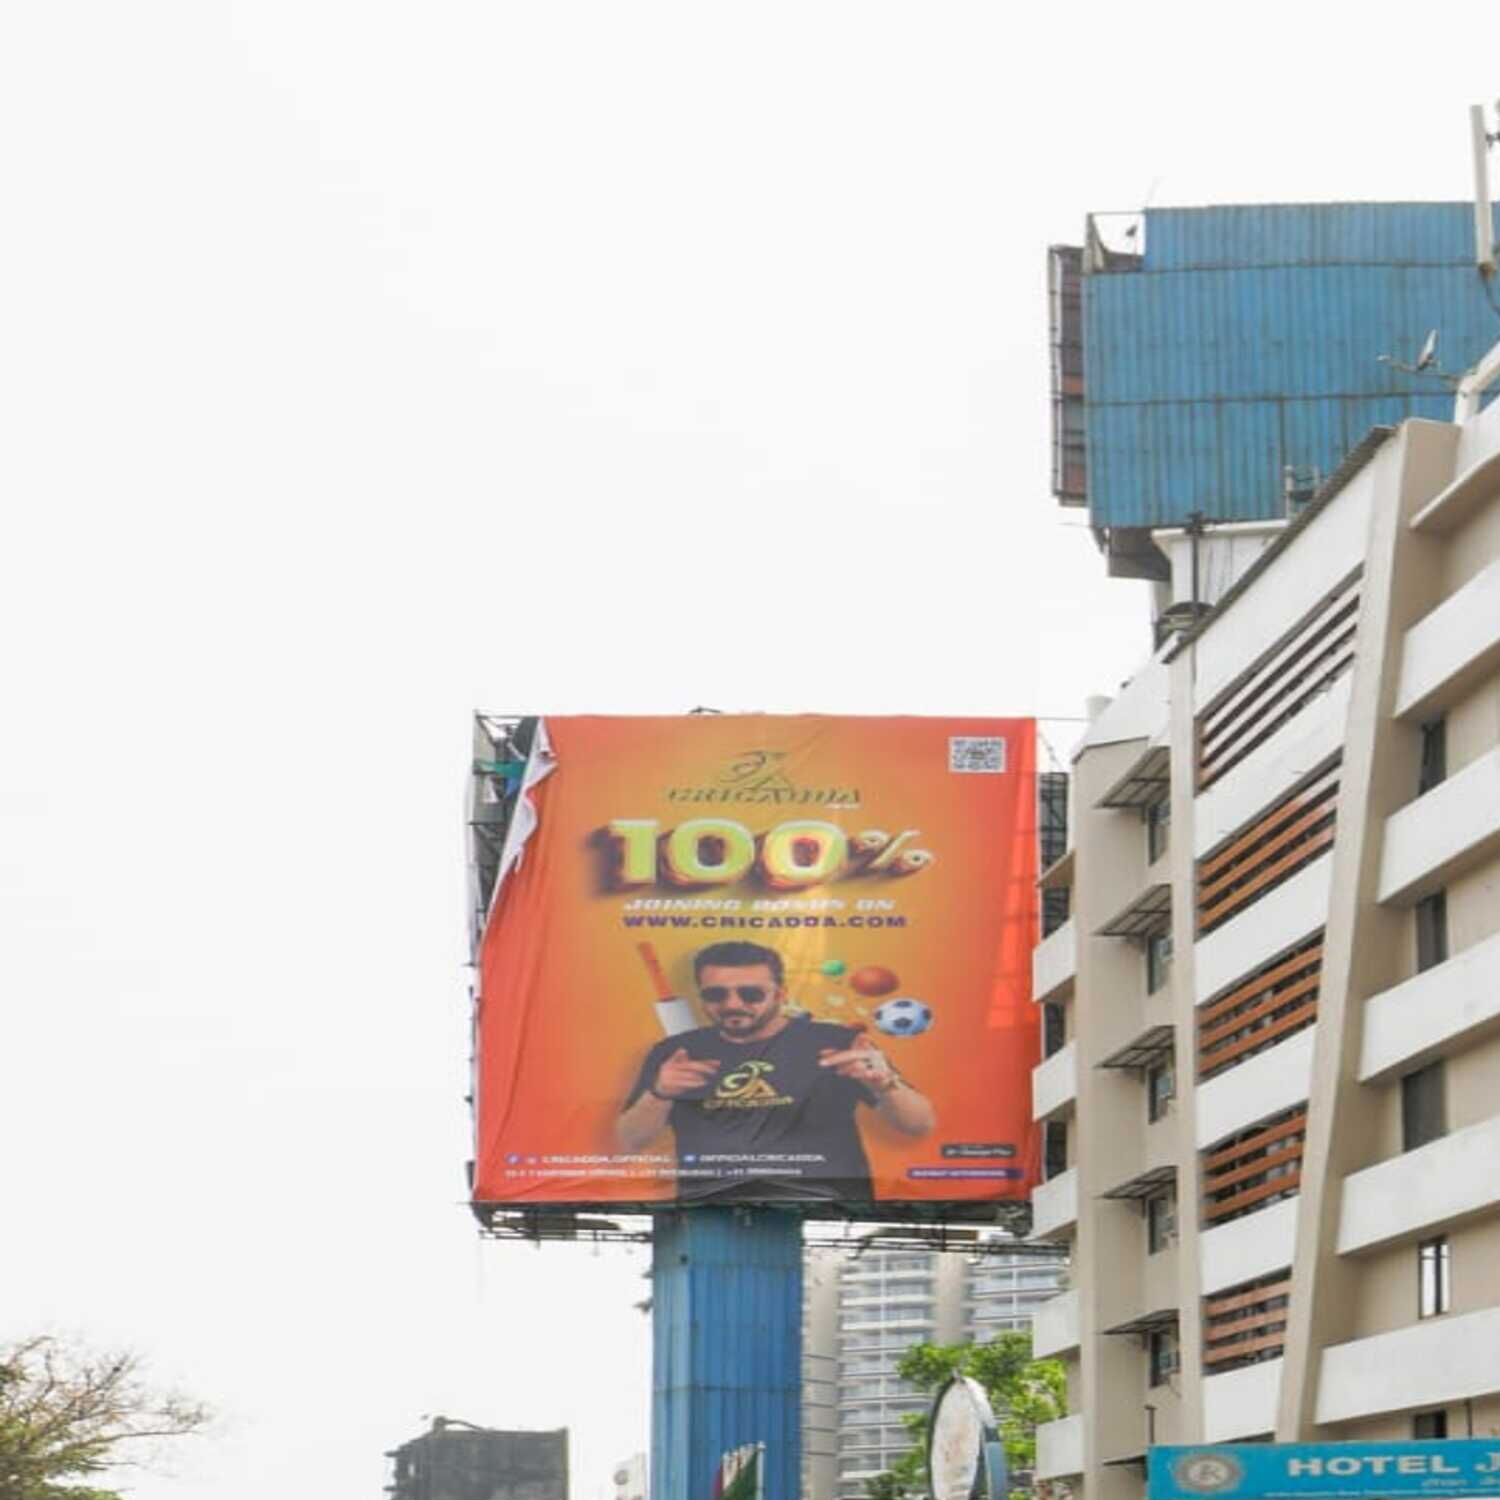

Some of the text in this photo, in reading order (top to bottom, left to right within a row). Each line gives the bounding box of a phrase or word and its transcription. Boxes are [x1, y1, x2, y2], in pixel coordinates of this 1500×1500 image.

[610, 818, 936, 886] 100%
[624, 900, 741, 912] JOINING
[855, 900, 896, 912] ON
[622, 916, 908, 930] WWW.CRICADDA.COM
[1287, 1455, 1460, 1477] HOTEL
